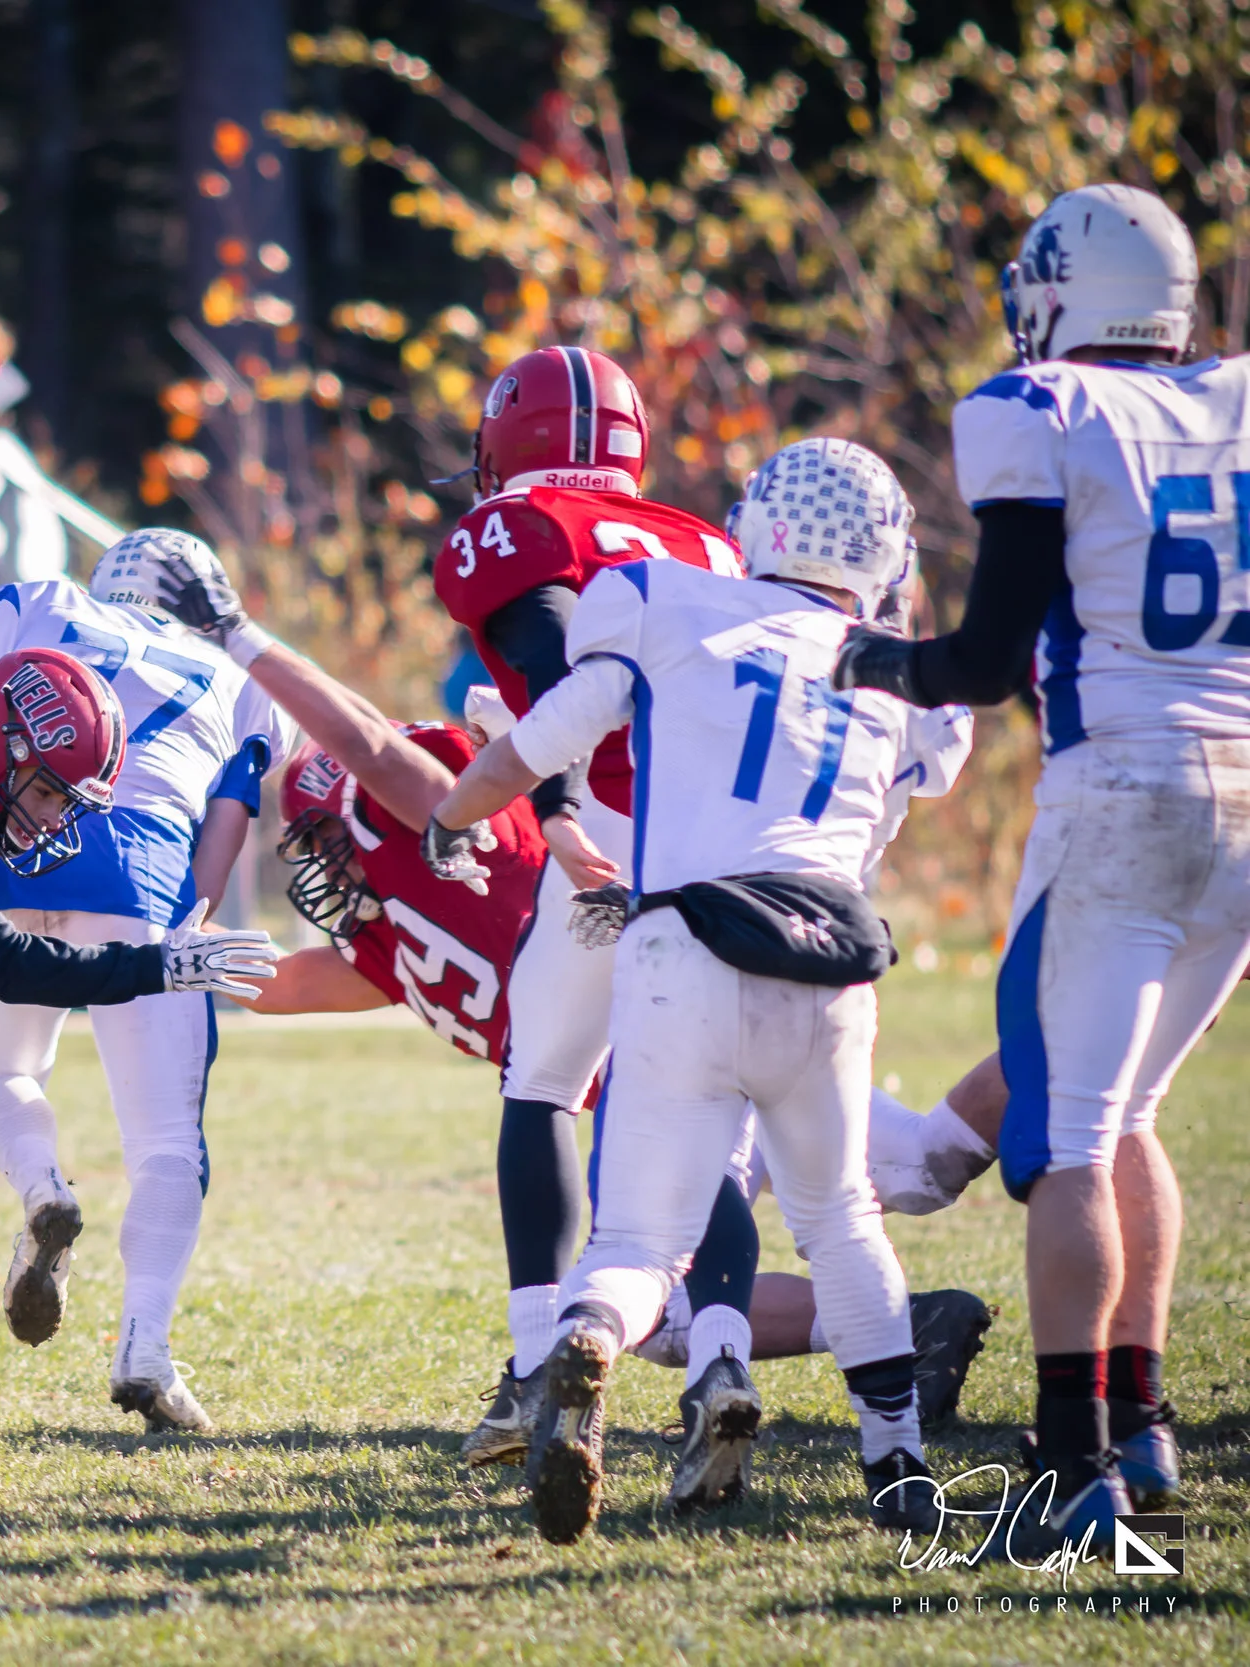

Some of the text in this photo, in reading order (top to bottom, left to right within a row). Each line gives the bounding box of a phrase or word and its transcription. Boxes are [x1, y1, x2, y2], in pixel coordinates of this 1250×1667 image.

[545, 472, 614, 490] Riddell
[450, 511, 517, 579] 34
[2, 662, 78, 753] WELLS
